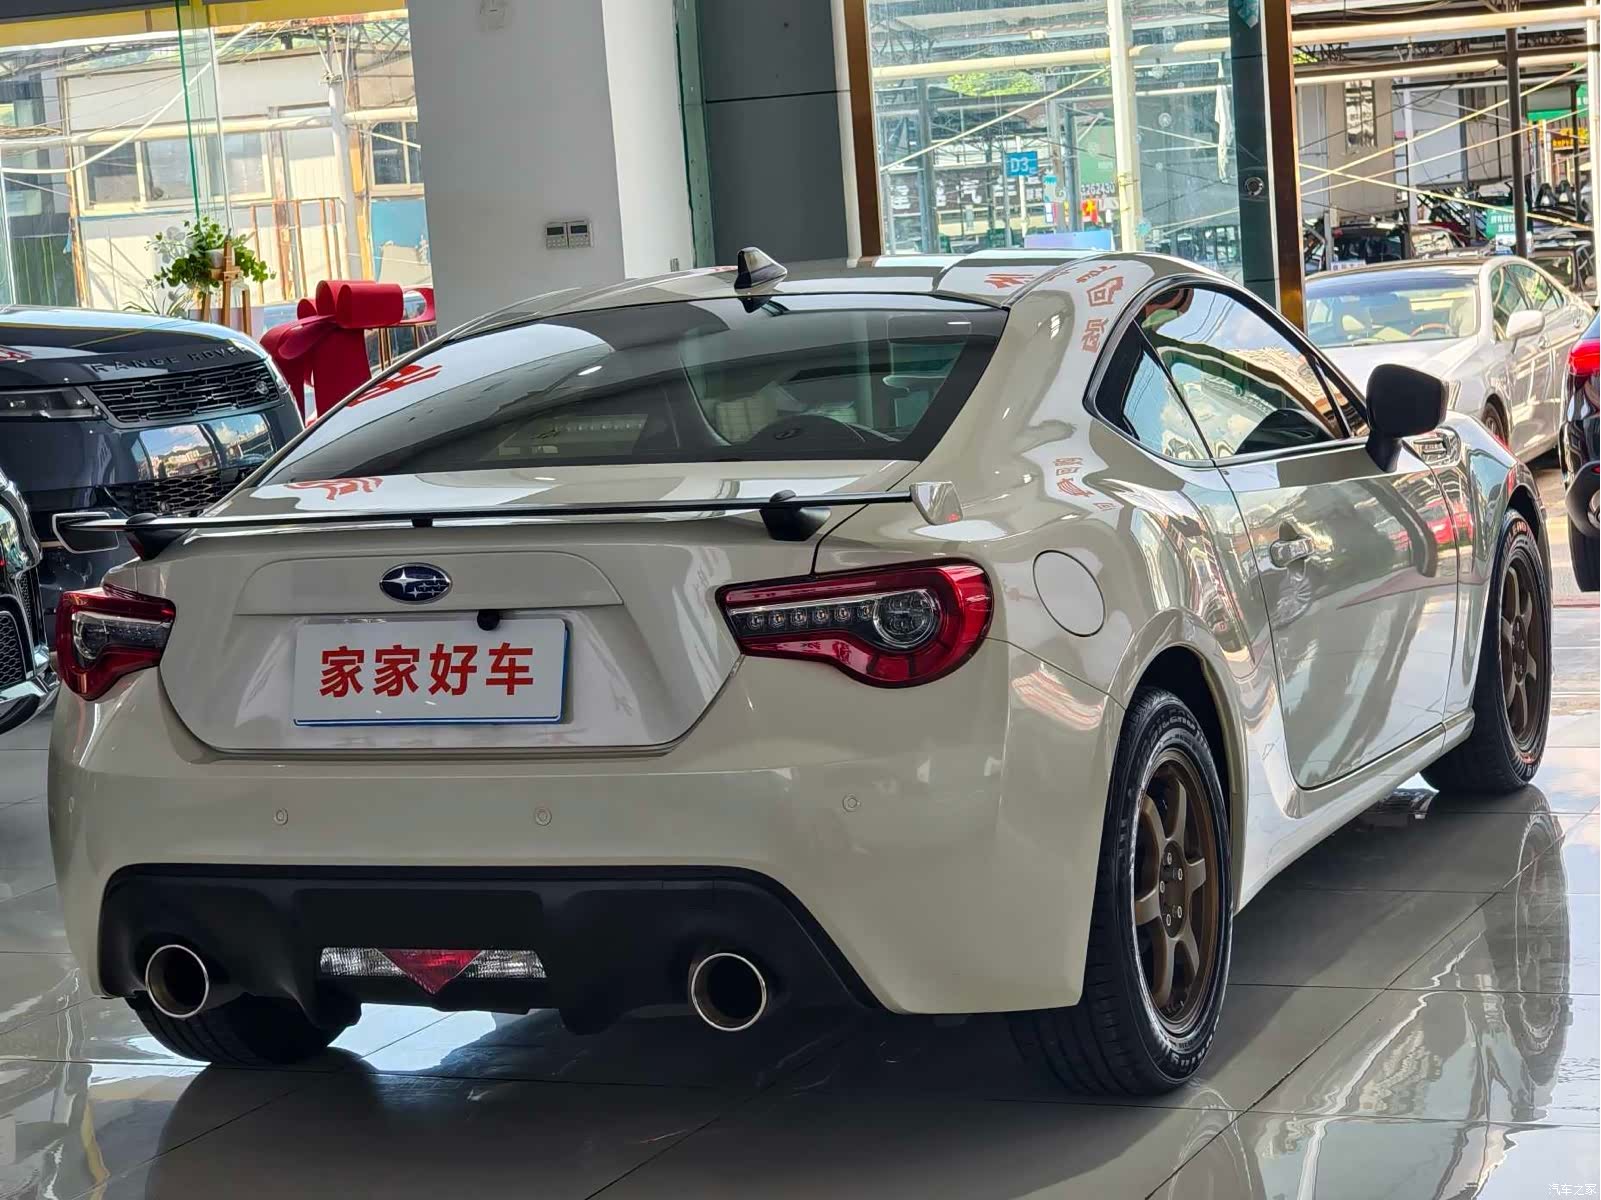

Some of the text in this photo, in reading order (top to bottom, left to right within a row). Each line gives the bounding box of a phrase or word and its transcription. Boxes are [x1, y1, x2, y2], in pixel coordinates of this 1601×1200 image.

[91, 355, 181, 373] RANGE
[319, 642, 534, 698] 家家好车
